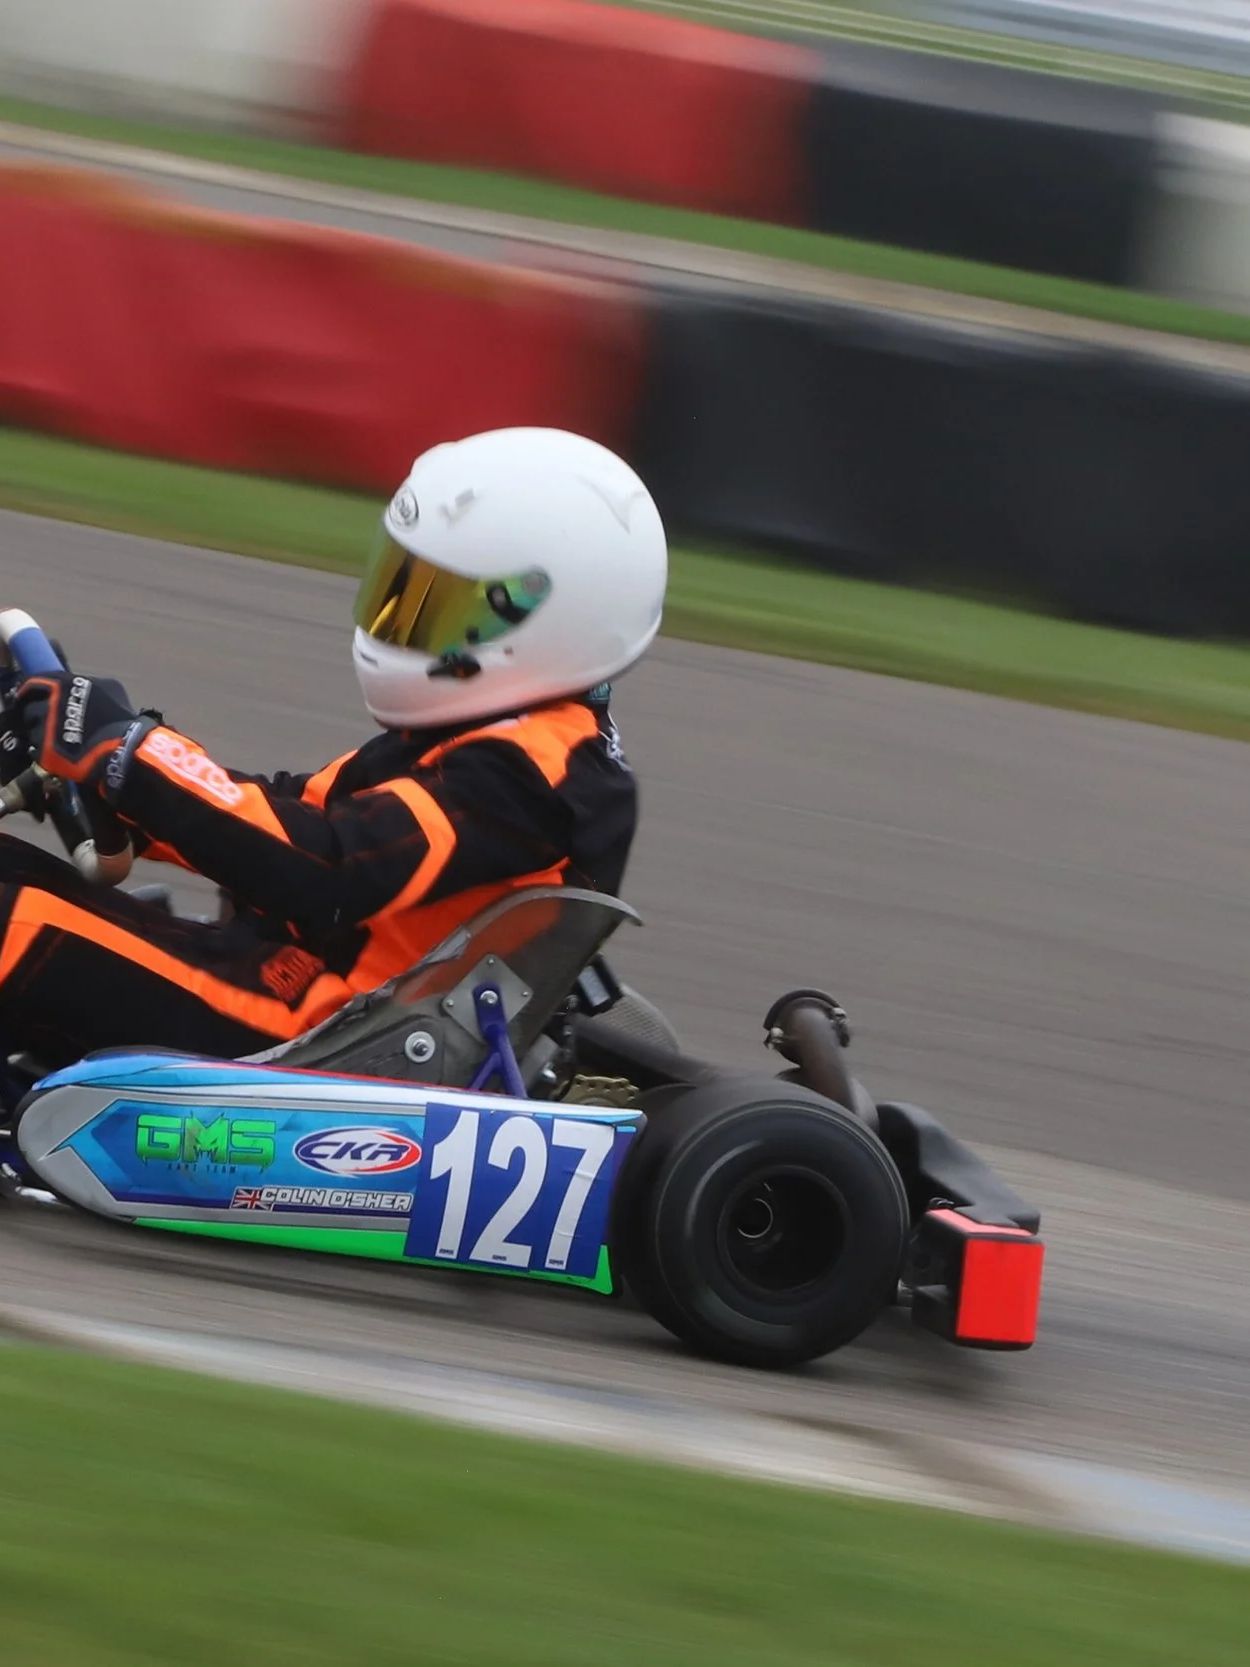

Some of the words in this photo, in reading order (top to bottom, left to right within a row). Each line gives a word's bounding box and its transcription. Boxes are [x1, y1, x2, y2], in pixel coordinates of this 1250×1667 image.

[136, 1111, 277, 1173] GMS
[299, 1140, 410, 1162] CKR
[262, 1187, 327, 1206] COLIN
[328, 1191, 412, 1211] O'SHEA
[430, 1110, 615, 1270] 127
